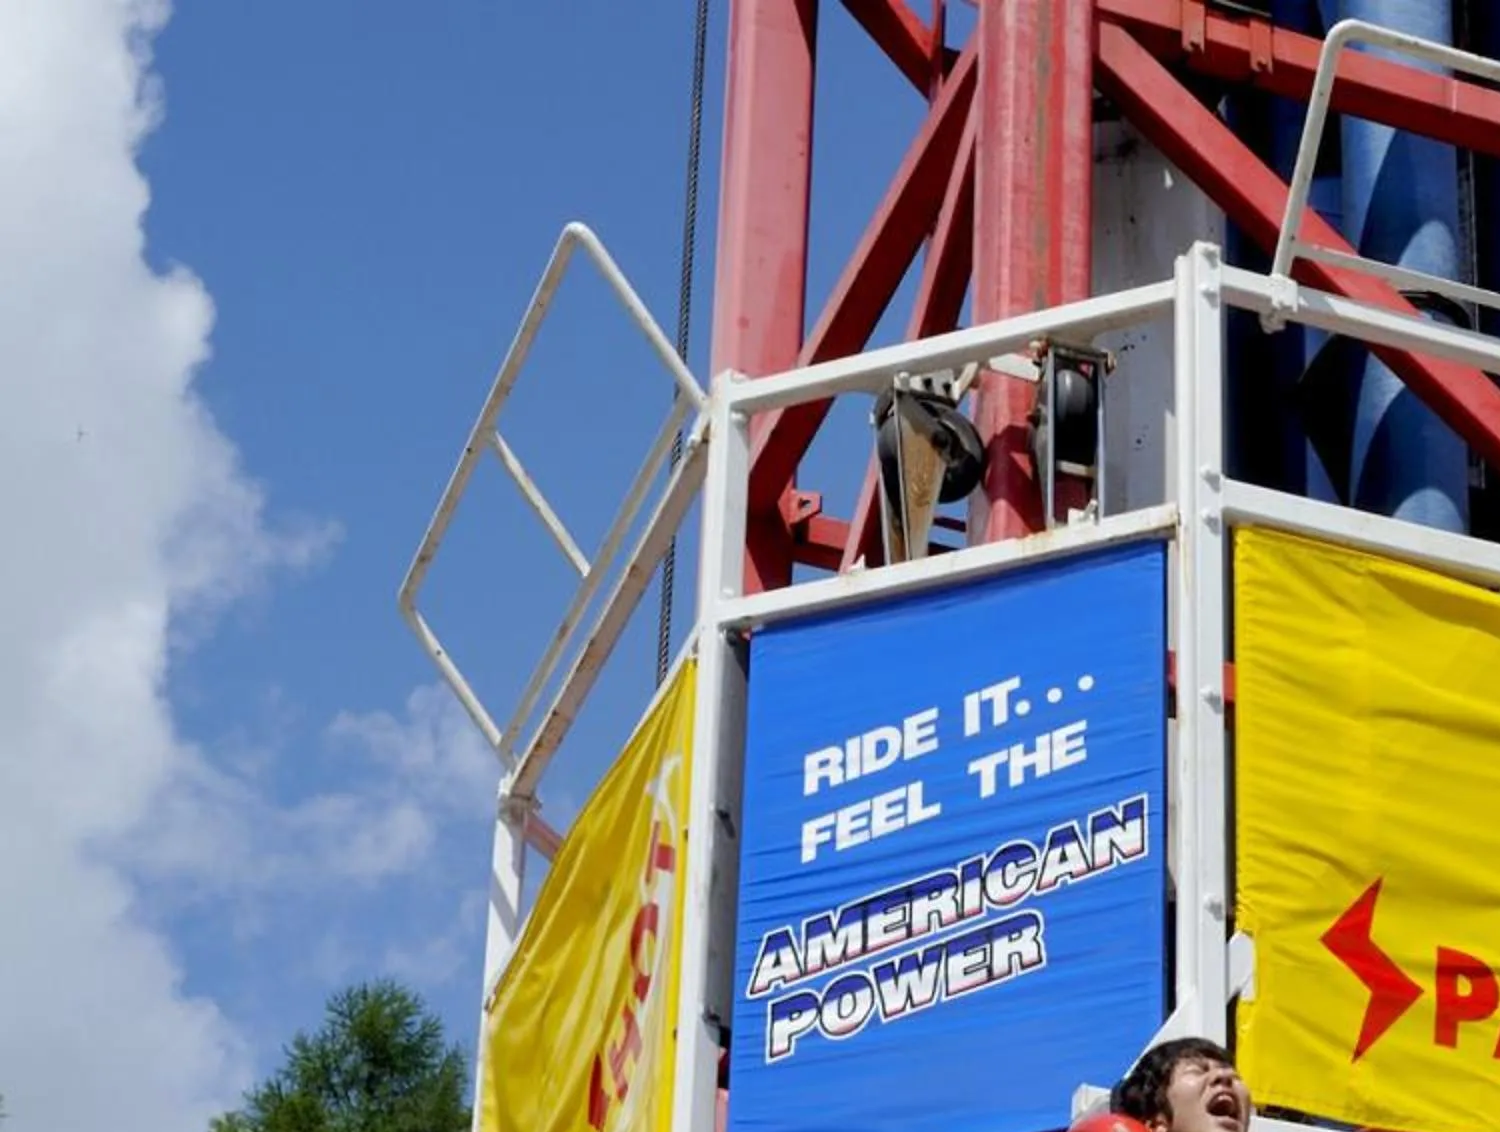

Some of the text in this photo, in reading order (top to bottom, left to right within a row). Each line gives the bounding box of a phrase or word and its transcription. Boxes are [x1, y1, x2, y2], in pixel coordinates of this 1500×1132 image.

[801, 719, 1087, 864] FEEL THE
[803, 707, 939, 797] RIDE
[746, 792, 1149, 999] AMERICAN
[765, 909, 1047, 1064] POWER
